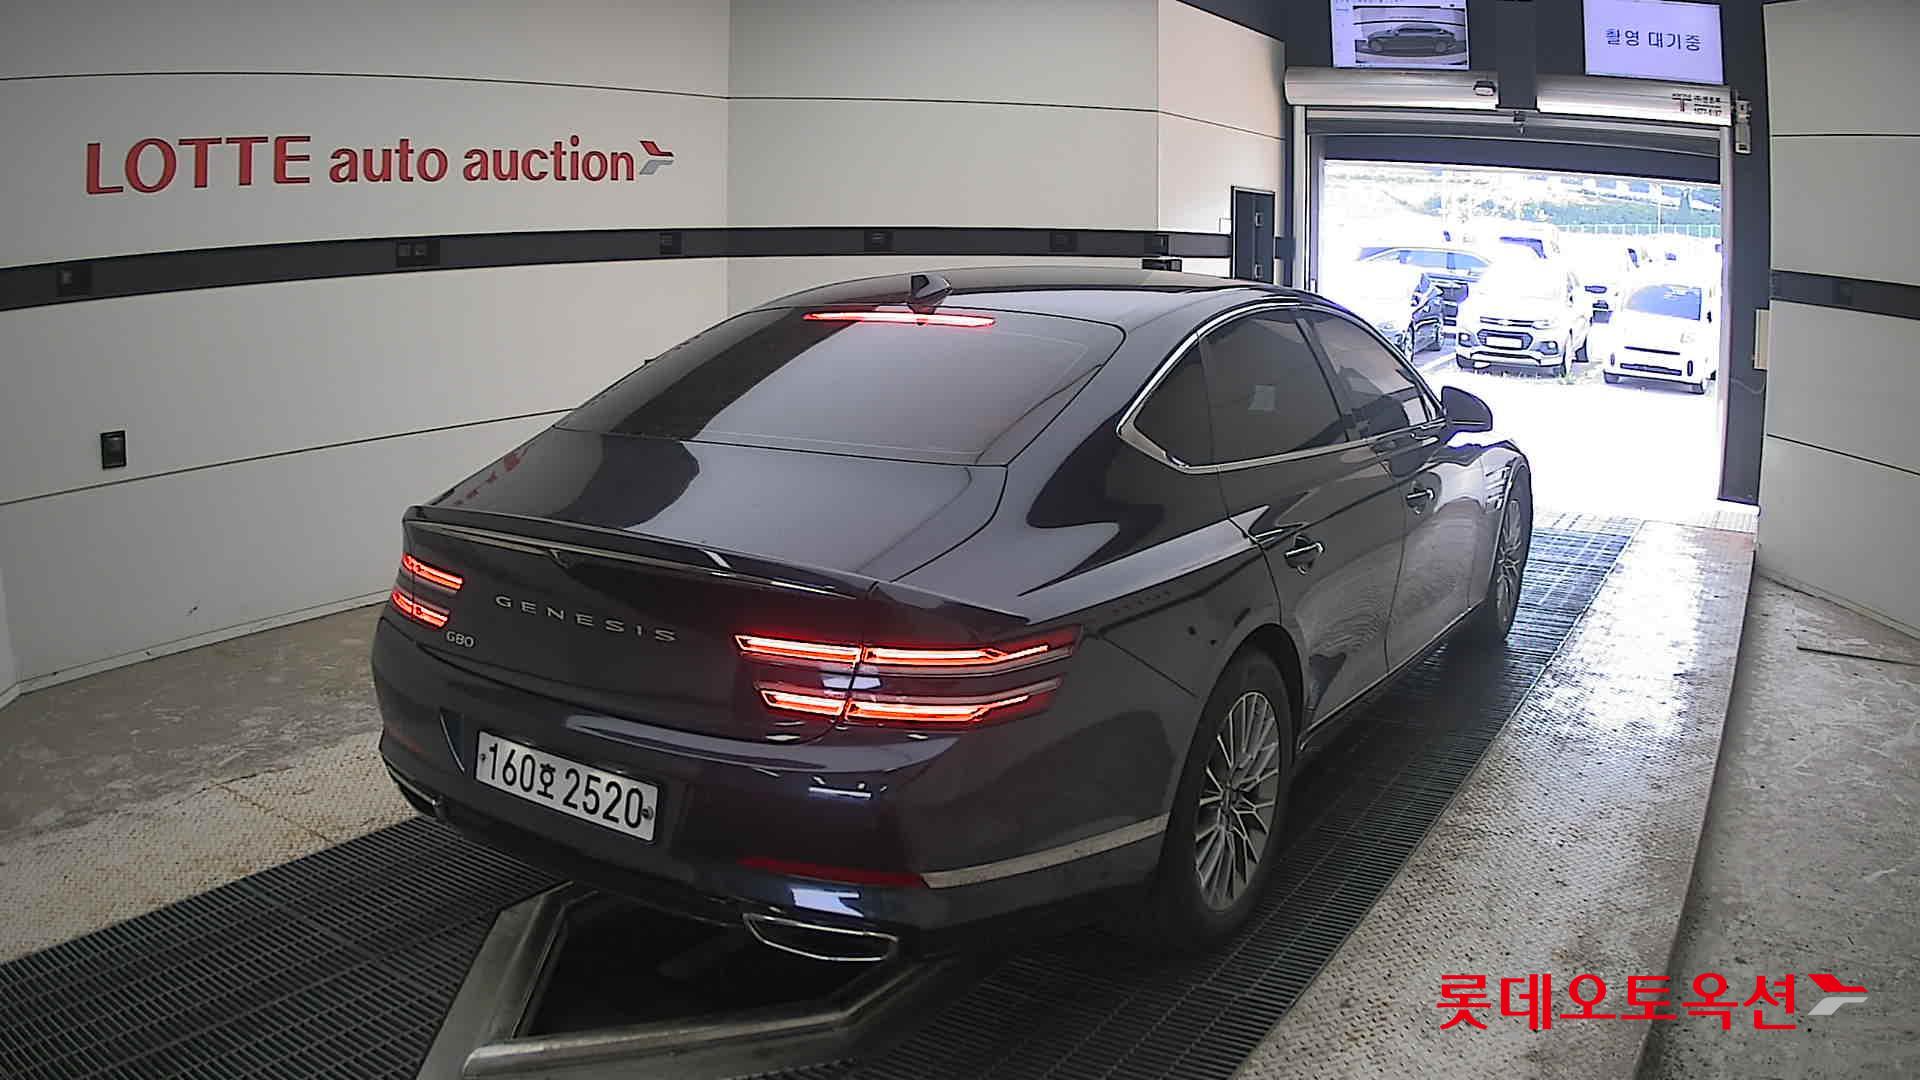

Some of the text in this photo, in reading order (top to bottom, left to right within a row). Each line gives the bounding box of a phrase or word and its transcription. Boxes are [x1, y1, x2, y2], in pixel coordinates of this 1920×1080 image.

[1648, 31, 1702, 51] 대기중
[85, 135, 635, 194] LOTTE auto auction
[445, 631, 475, 649] G80
[495, 595, 677, 643] GENESIS
[489, 743, 644, 829] 160호 2520
